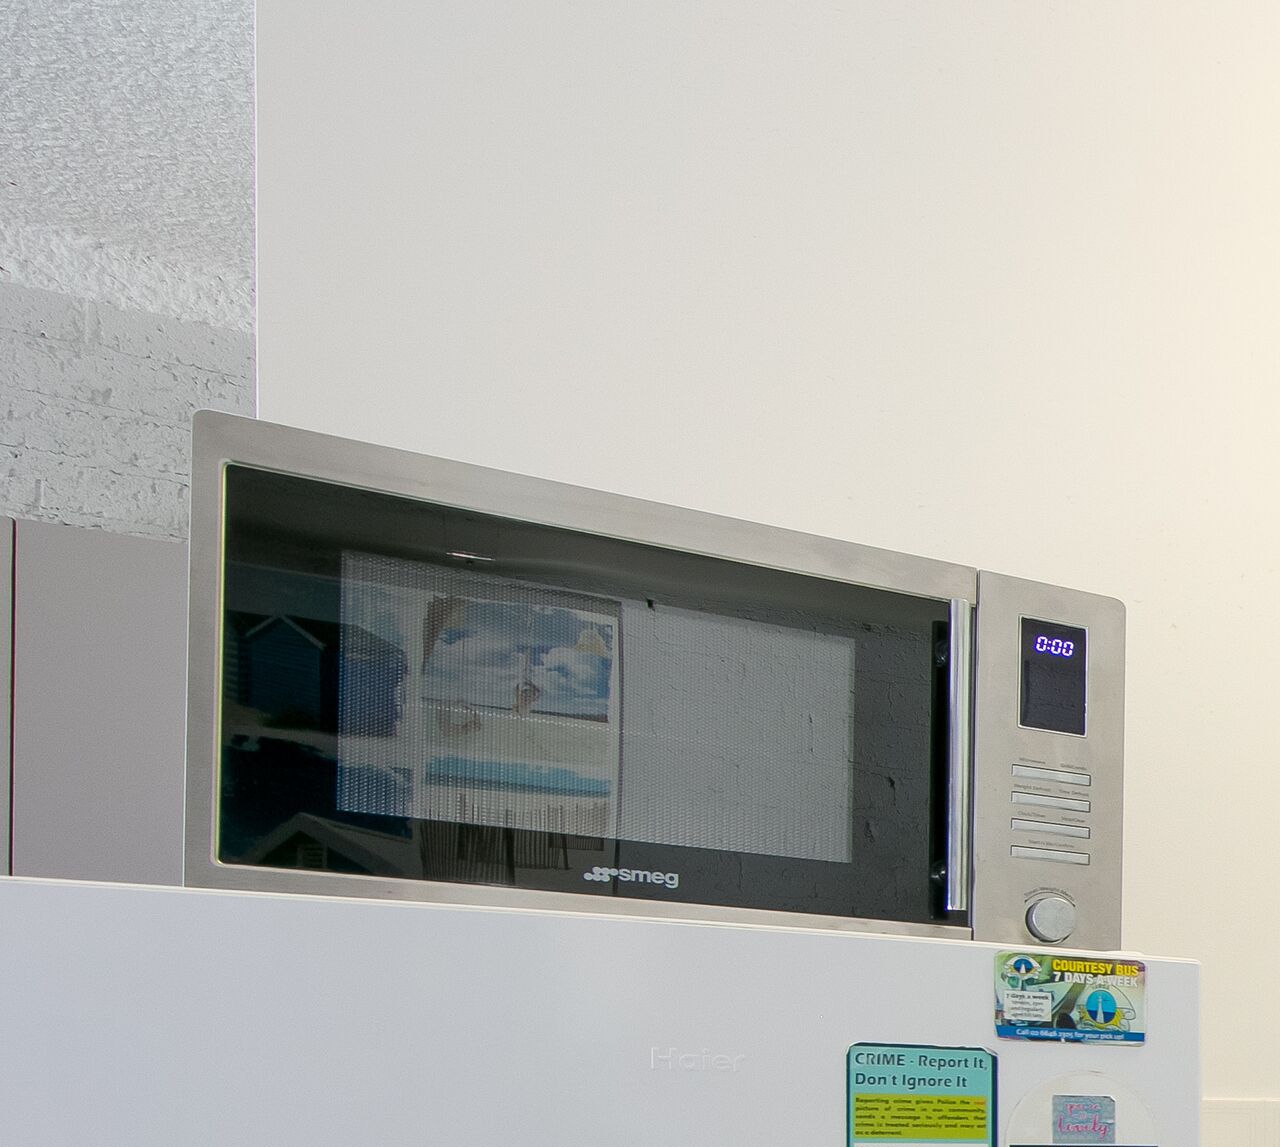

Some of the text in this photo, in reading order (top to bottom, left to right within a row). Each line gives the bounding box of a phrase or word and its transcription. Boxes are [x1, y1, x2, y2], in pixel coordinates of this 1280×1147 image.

[1036, 636, 1074, 657] 0:00
[618, 868, 679, 888] smeg
[1052, 959, 1139, 976] COURTESY BUS
[1053, 971, 1138, 988] 7 DAYS A WEEK
[1016, 1028, 1030, 1036] Call
[855, 1053, 906, 1066] CRIME
[918, 1055, 969, 1071] Report
[902, 1074, 952, 1090] Ignore
[956, 1076, 967, 1088] It
